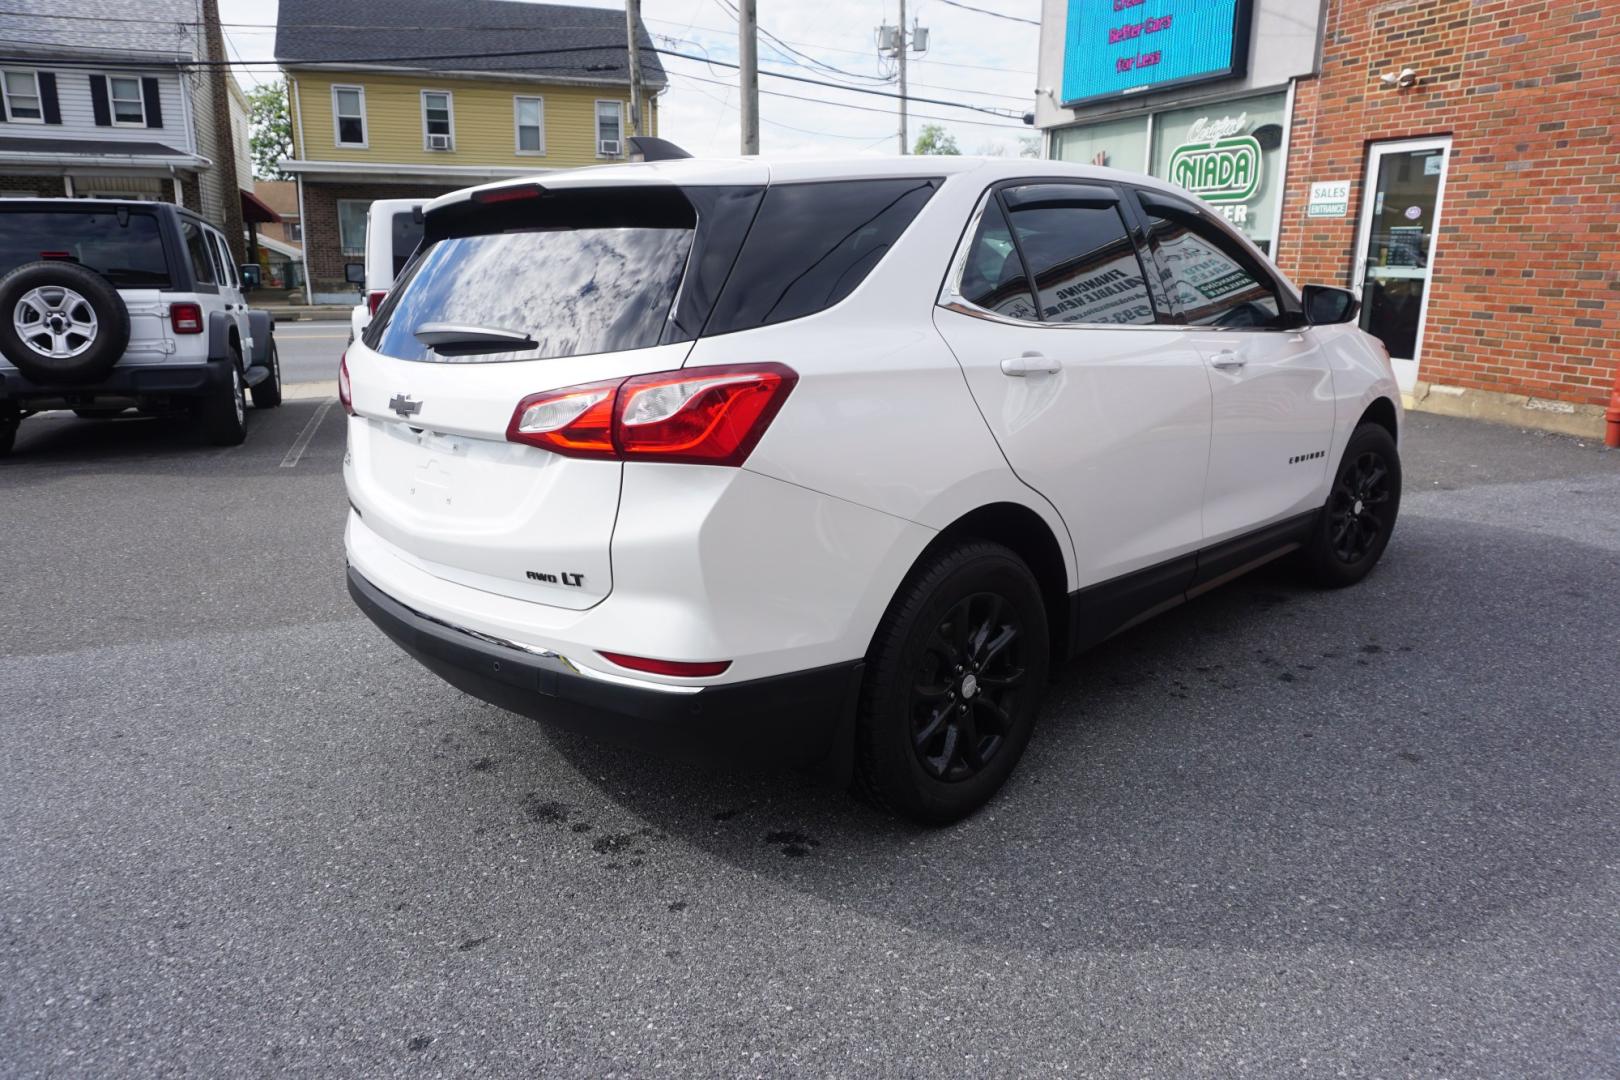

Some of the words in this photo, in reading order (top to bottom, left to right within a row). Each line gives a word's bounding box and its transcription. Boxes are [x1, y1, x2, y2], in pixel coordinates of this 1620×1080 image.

[1108, 22, 1143, 45] Better
[1144, 14, 1173, 34] Cars
[1136, 50, 1162, 69] Less
[1174, 149, 1252, 190] NIADA
[1314, 187, 1346, 199] SALES
[1311, 203, 1345, 214] ENTRANCE
[1289, 450, 1325, 465] EQUINOX
[526, 571, 557, 584] AWD
[561, 571, 585, 587] LT
